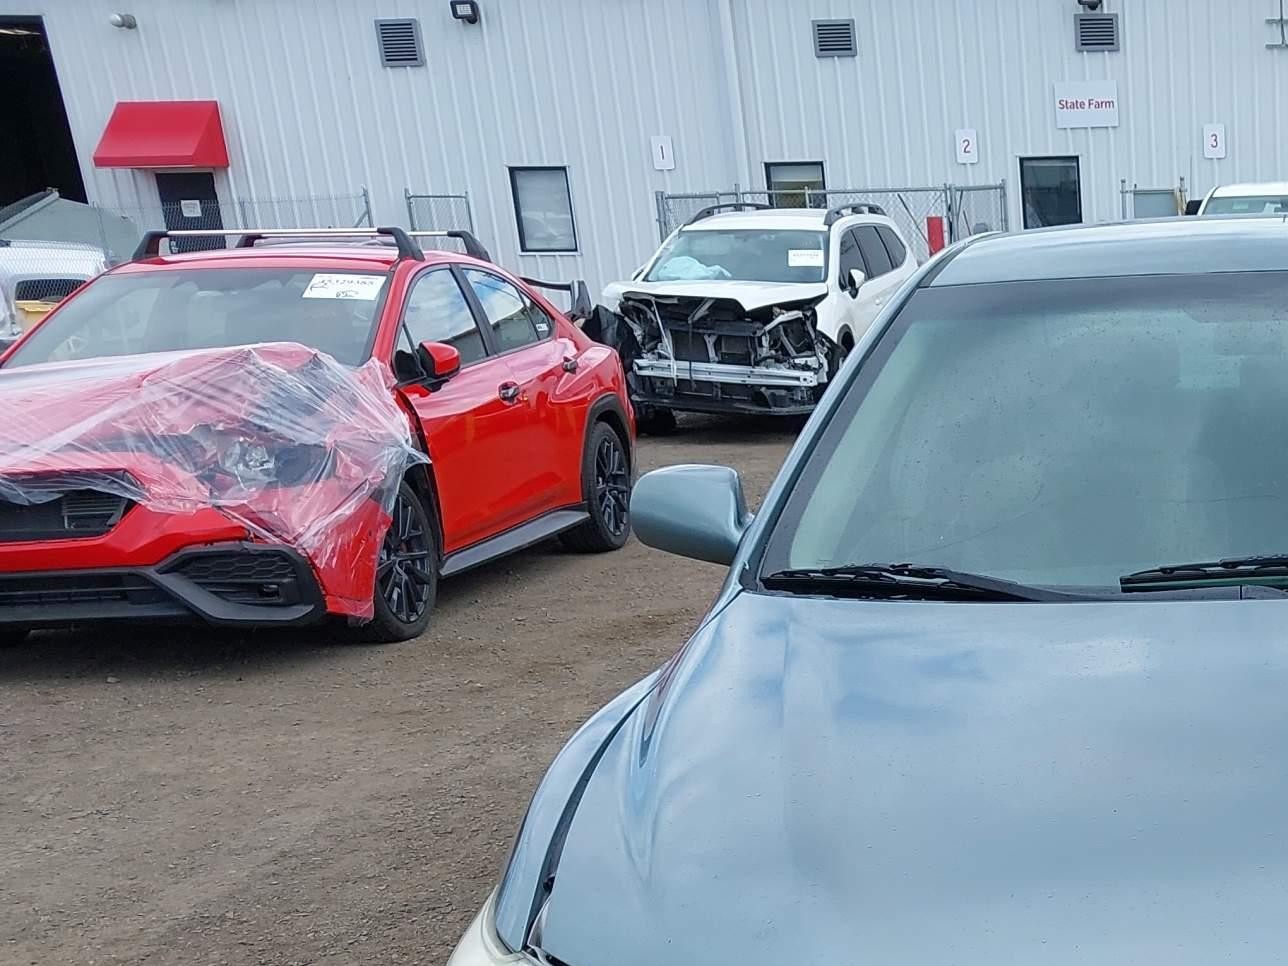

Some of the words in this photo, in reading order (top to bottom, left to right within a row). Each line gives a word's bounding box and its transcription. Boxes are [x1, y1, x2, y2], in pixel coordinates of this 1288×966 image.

[1058, 98, 1086, 110] State
[1088, 98, 1115, 110] Farm
[962, 139, 971, 154] 2
[1210, 133, 1218, 148] 3
[659, 145, 665, 160] 1
